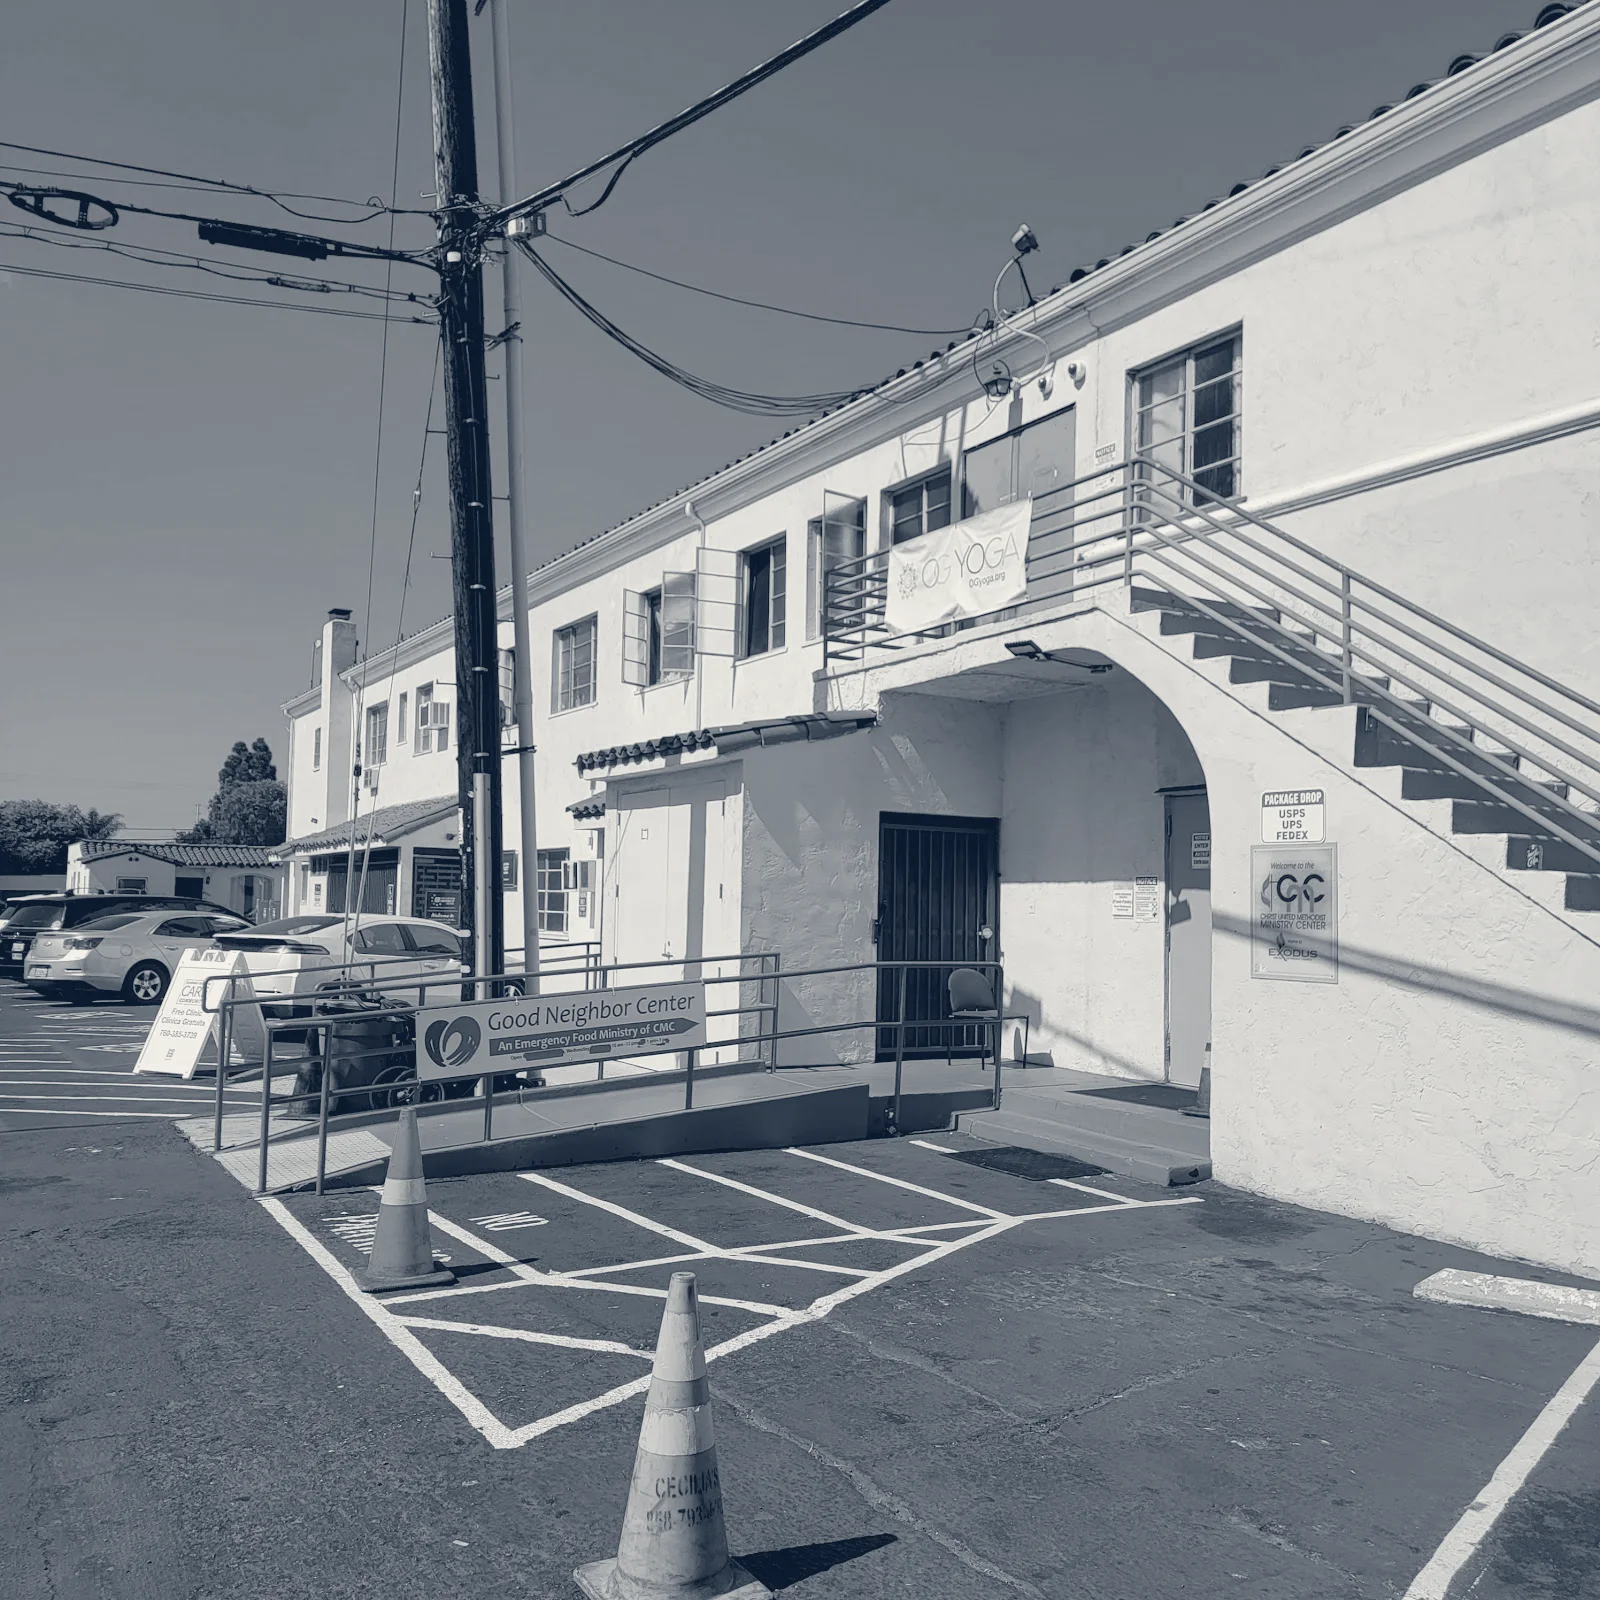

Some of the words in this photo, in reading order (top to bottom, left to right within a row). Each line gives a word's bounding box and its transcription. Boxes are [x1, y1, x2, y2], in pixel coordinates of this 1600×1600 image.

[954, 532, 1020, 578] YOGA
[1264, 793, 1299, 806] PACKAGE
[1300, 791, 1322, 804] DROP
[1279, 808, 1306, 819] USPS
[1282, 819, 1303, 830] UPS
[1276, 830, 1309, 841] FEDEX
[1270, 862, 1297, 870] Welcome
[1297, 862, 1304, 870] to
[1304, 861, 1315, 870] the
[1278, 913, 1296, 921] UNITED
[1297, 913, 1327, 922] METHODIST
[1260, 920, 1294, 930] MINISTRY
[1295, 920, 1327, 931] CENTER
[1268, 947, 1319, 962] EXODUS
[171, 1008, 185, 1016] Free
[185, 1009, 203, 1017] Clinic
[488, 1006, 540, 1031] Good
[545, 999, 632, 1027] Neighbor
[636, 995, 695, 1015] Center
[160, 1017, 181, 1025] Clinica
[497, 1041, 513, 1052] An
[514, 1035, 571, 1050] Emergency
[572, 1030, 597, 1043] Food
[599, 1026, 638, 1041] Ministry
[639, 1024, 651, 1035] of
[652, 1021, 676, 1034] CMC
